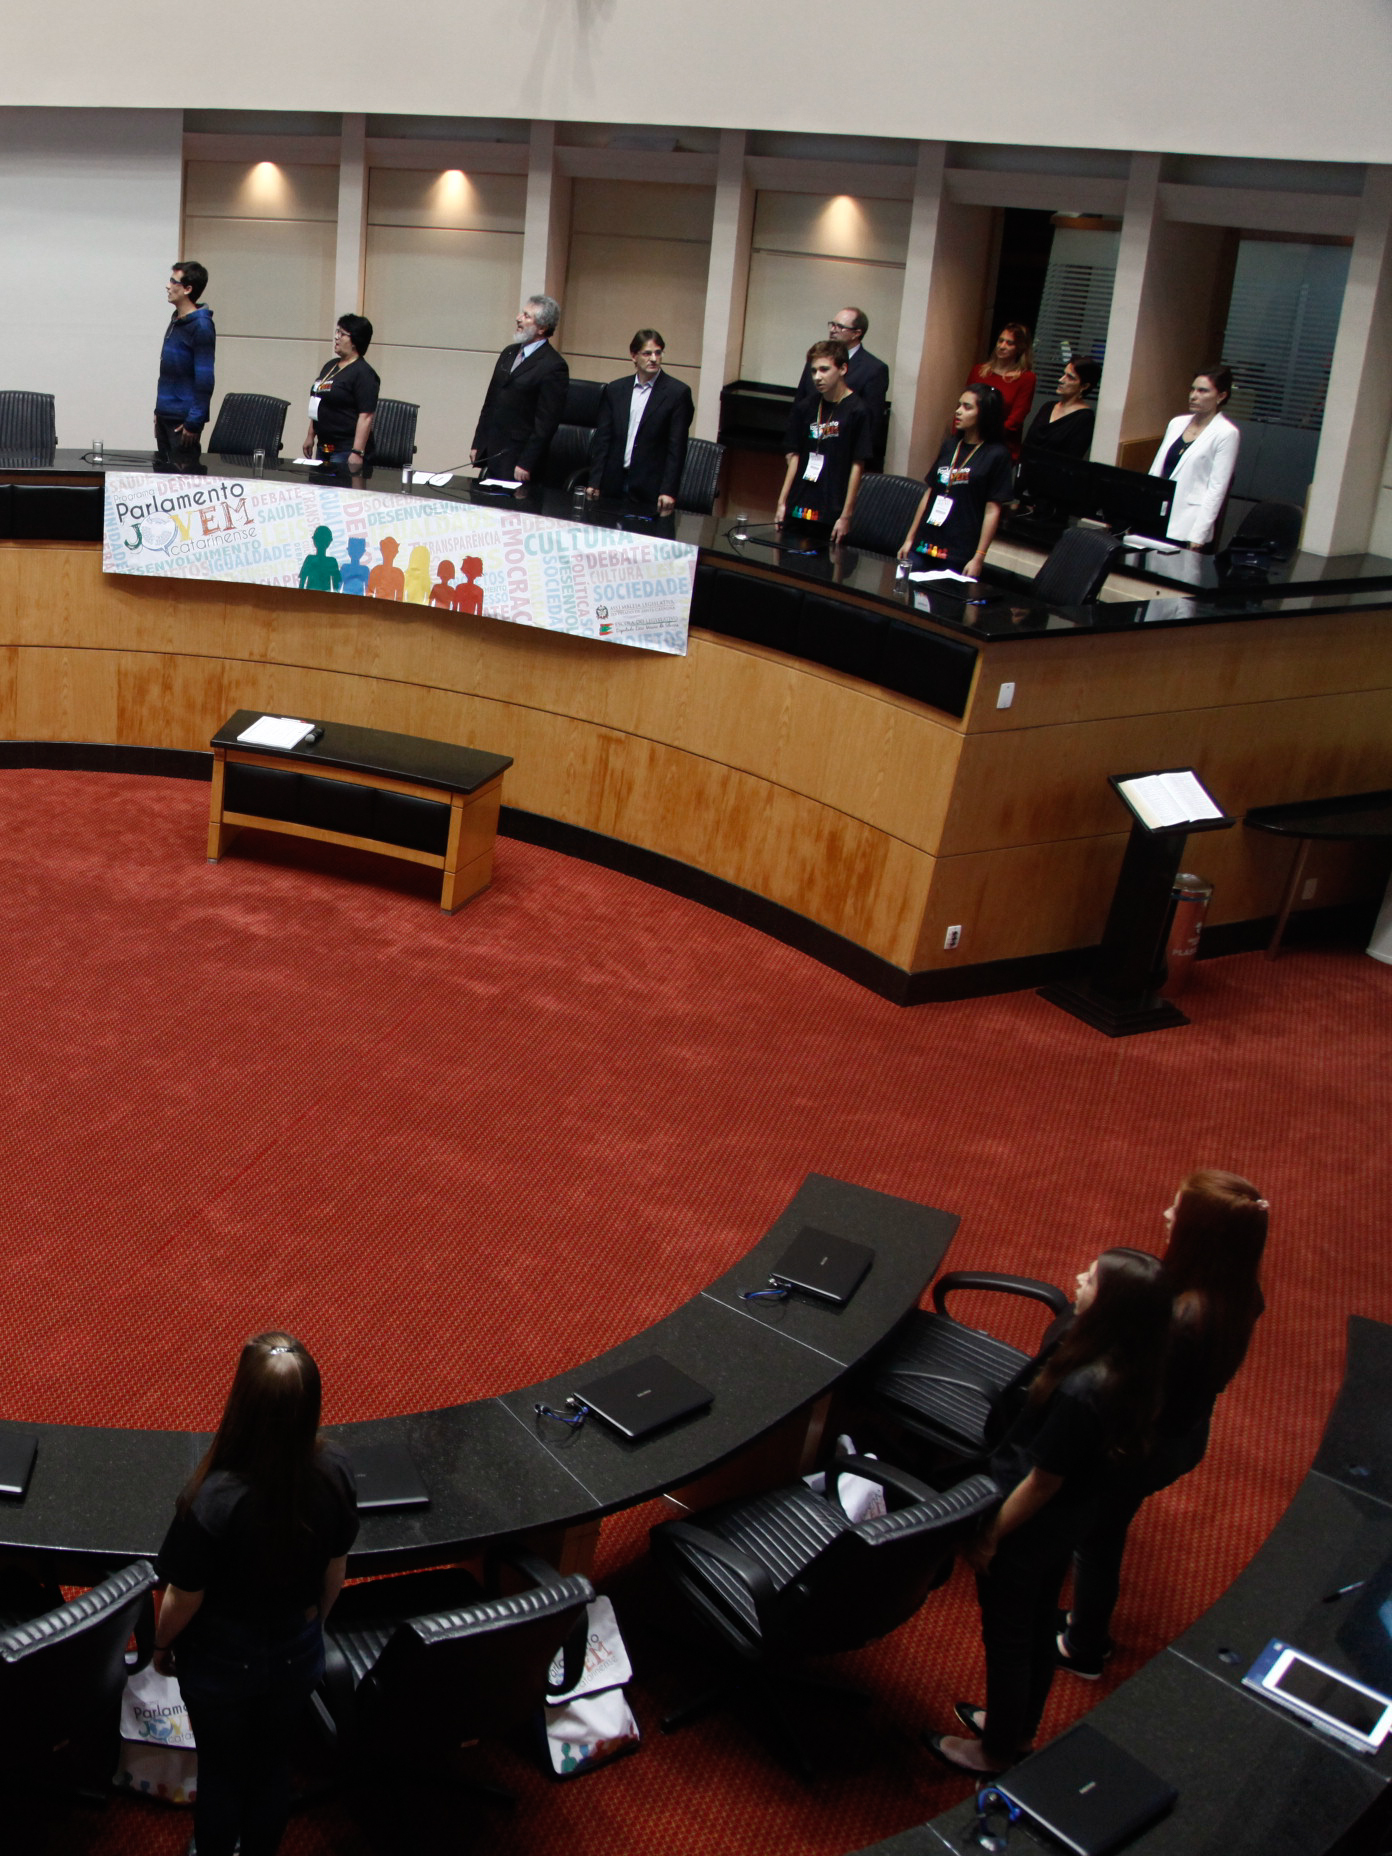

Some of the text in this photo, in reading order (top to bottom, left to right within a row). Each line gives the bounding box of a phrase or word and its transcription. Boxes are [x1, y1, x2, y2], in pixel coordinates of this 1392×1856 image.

[114, 488, 155, 503] Programa
[116, 482, 245, 523] Parlamento
[251, 486, 303, 508] DEBATE
[124, 497, 254, 557] JOVEM
[171, 527, 258, 556] catarinense
[524, 527, 634, 557] CULTURA
[208, 543, 293, 574] IGUALDADE
[586, 544, 652, 570] DEBATE
[589, 564, 644, 585] CULTURA
[593, 577, 690, 602] SOCIEDADE
